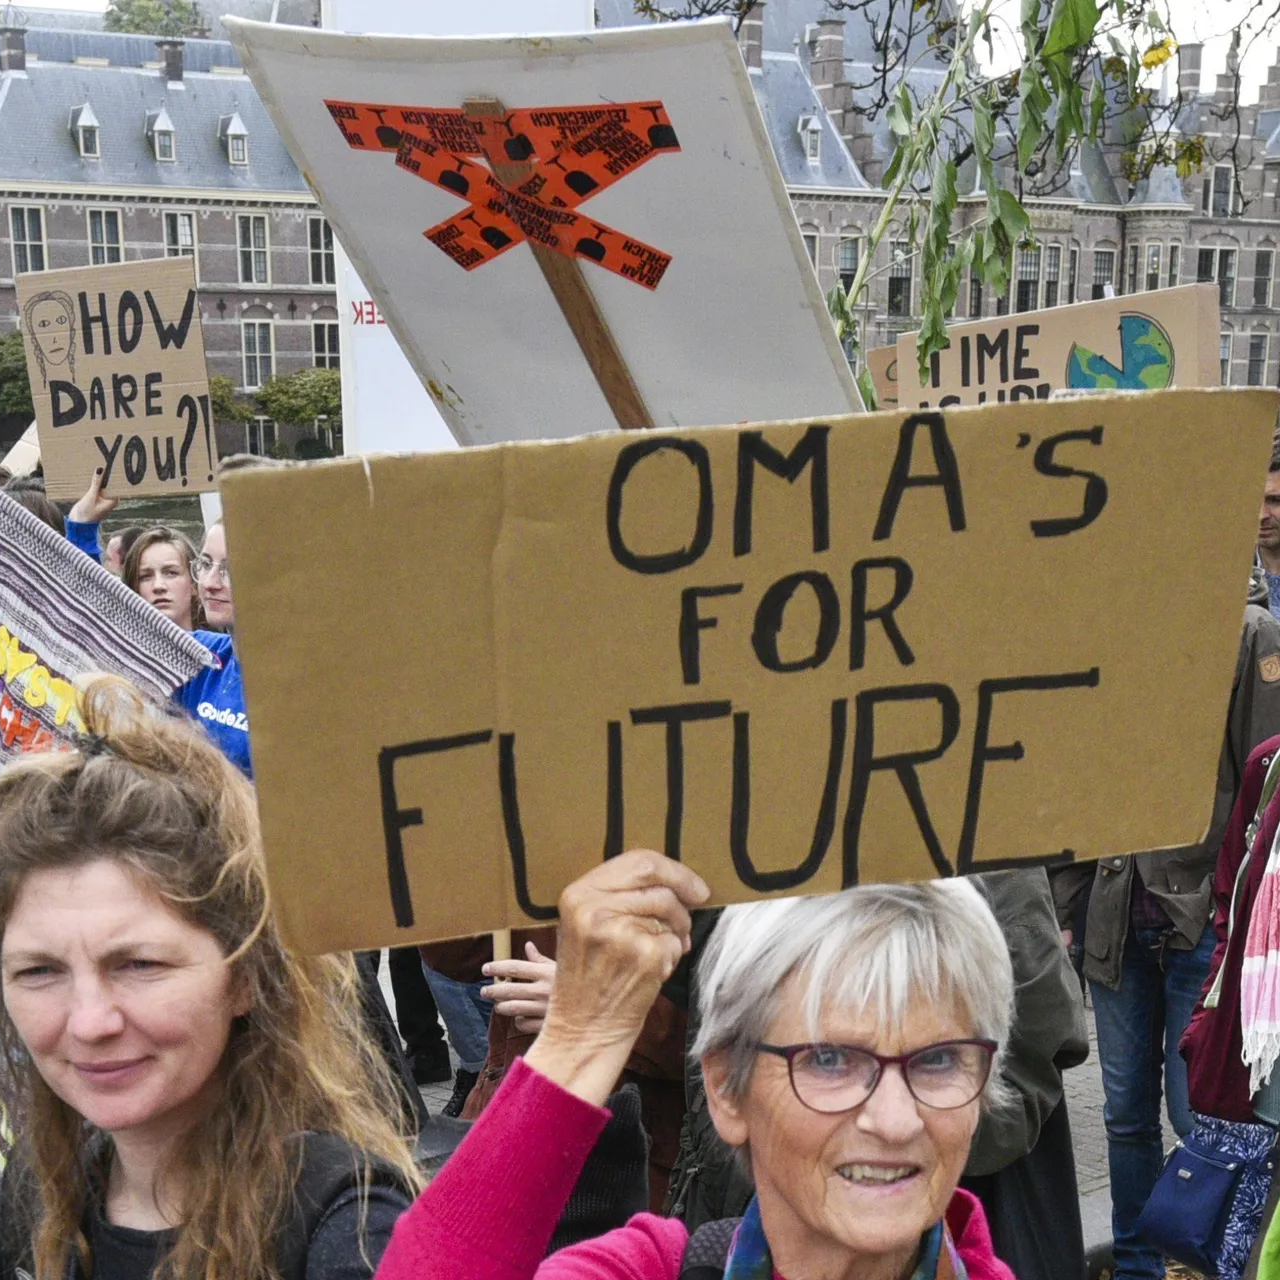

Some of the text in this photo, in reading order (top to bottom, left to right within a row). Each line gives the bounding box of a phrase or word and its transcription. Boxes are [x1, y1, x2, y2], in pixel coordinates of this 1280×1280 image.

[78, 289, 196, 355] HOW
[928, 324, 1040, 388] TIME
[49, 372, 163, 429] DARE
[606, 413, 1109, 575] OMA'S
[677, 556, 915, 685] FOR
[377, 666, 1101, 928] FUTURE
